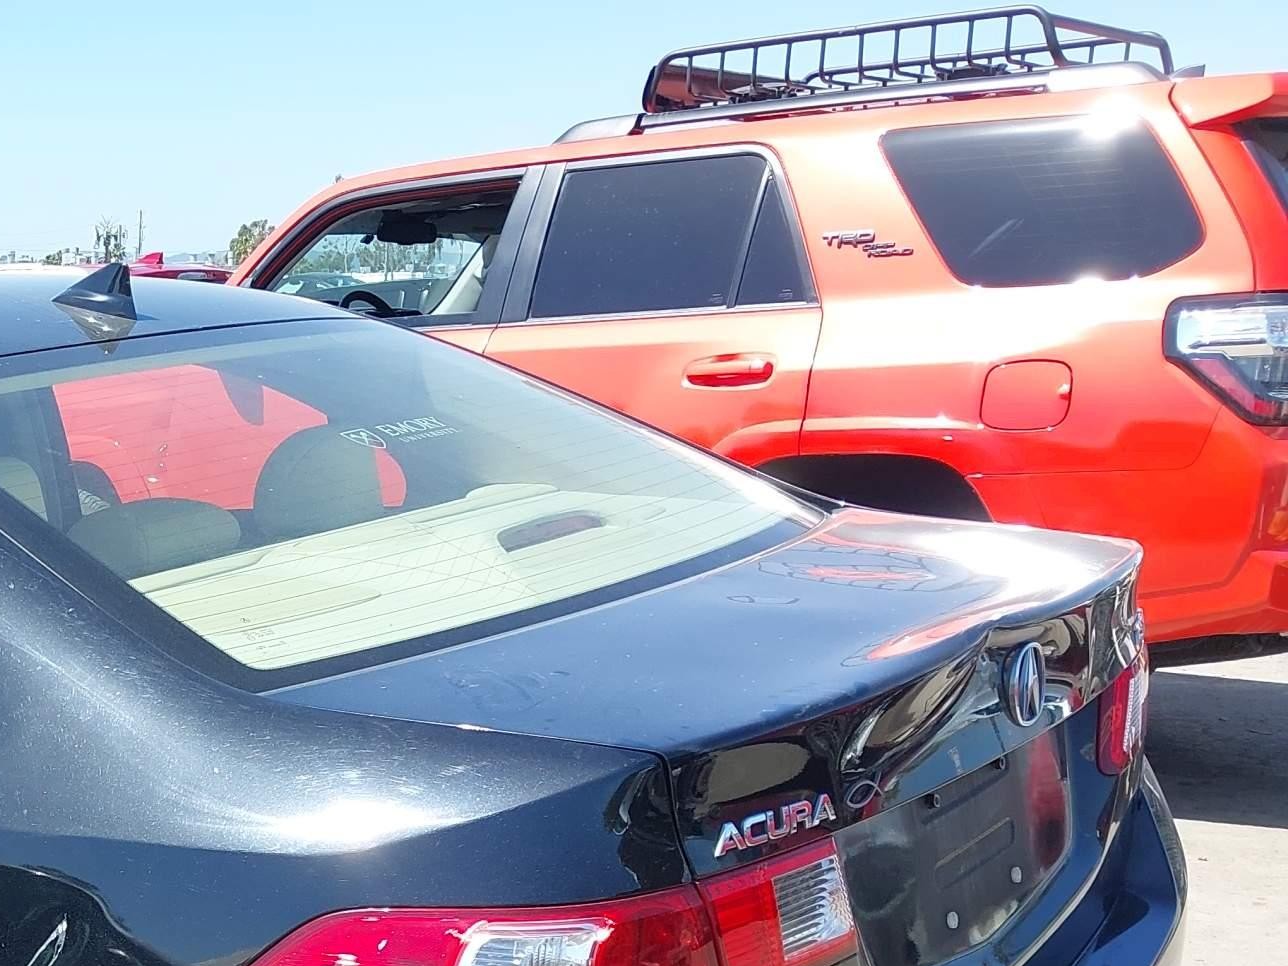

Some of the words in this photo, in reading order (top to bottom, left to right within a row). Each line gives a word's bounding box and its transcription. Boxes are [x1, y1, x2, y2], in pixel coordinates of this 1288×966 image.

[822, 230, 876, 249] TRD
[375, 416, 447, 437] EMORY
[714, 792, 837, 858] ACURA
